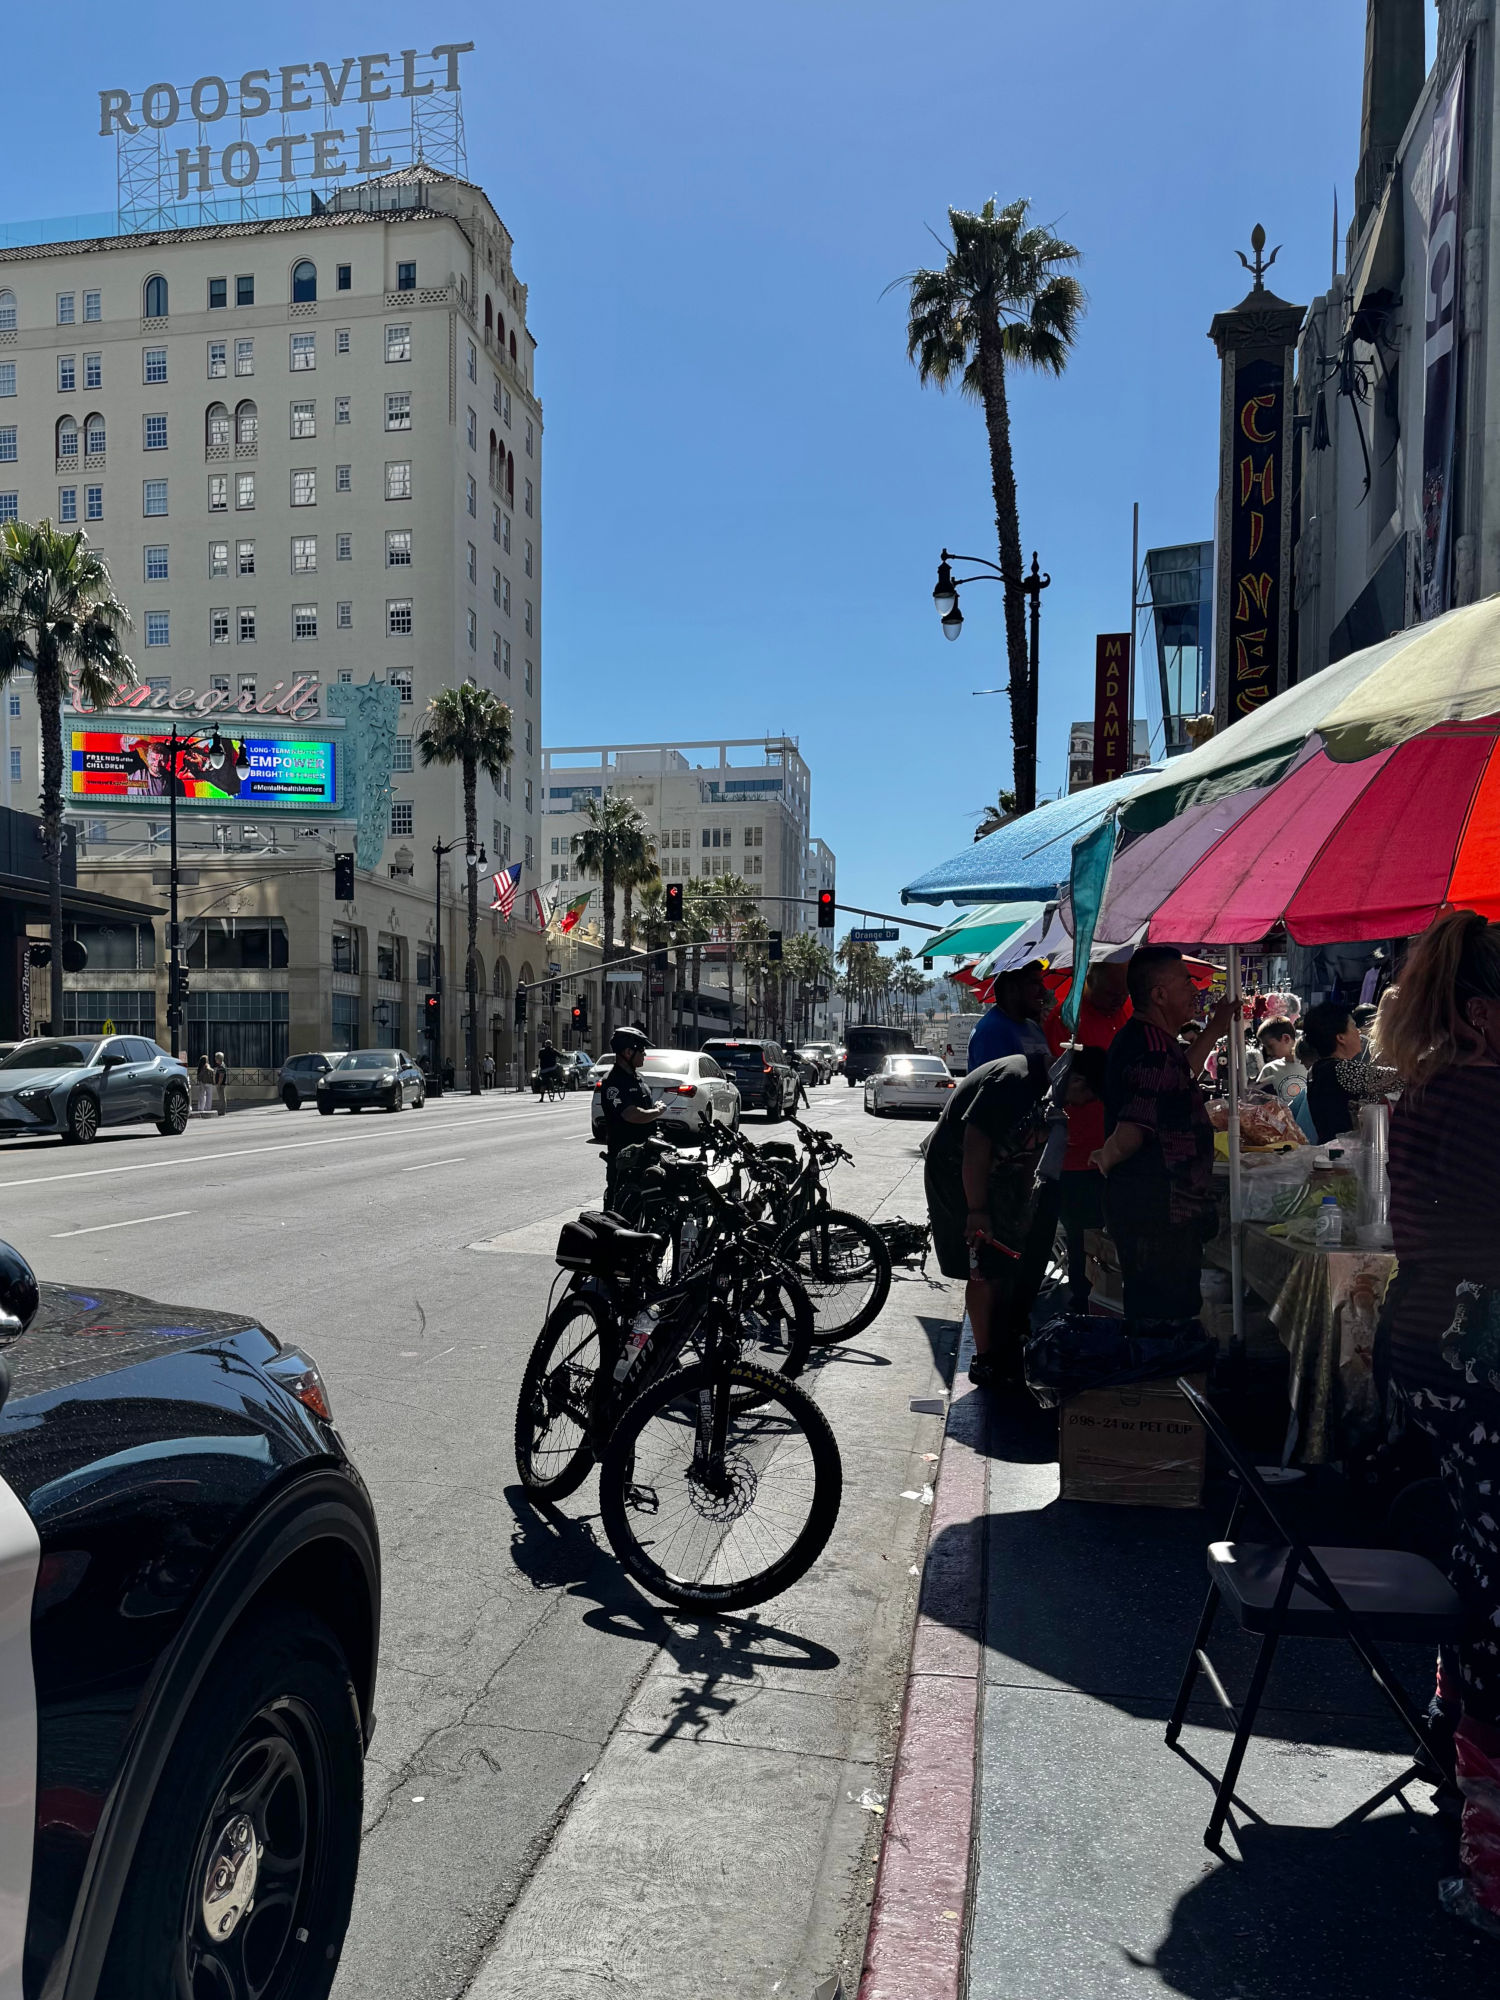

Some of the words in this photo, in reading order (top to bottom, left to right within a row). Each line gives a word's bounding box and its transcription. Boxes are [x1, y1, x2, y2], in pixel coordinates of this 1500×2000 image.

[98, 41, 475, 137] ROOSEVELT
[175, 125, 392, 200] HOTEL
[1103, 641, 1121, 757] MADAME
[250, 755, 325, 769] EMPOWER
[250, 769, 283, 778] BRIGHT
[253, 784, 322, 793] #MentalHealthMatters
[855, 931, 883, 940] Orange
[886, 930, 896, 938] Dr
[22, 994, 30, 1036] Coffee
[628, 1338, 654, 1383] LAPD
[729, 1367, 788, 1395] MAXXIS
[1121, 1422, 1135, 1431] oz
[1140, 1421, 1161, 1433] PET
[1166, 1423, 1192, 1434] CUP
